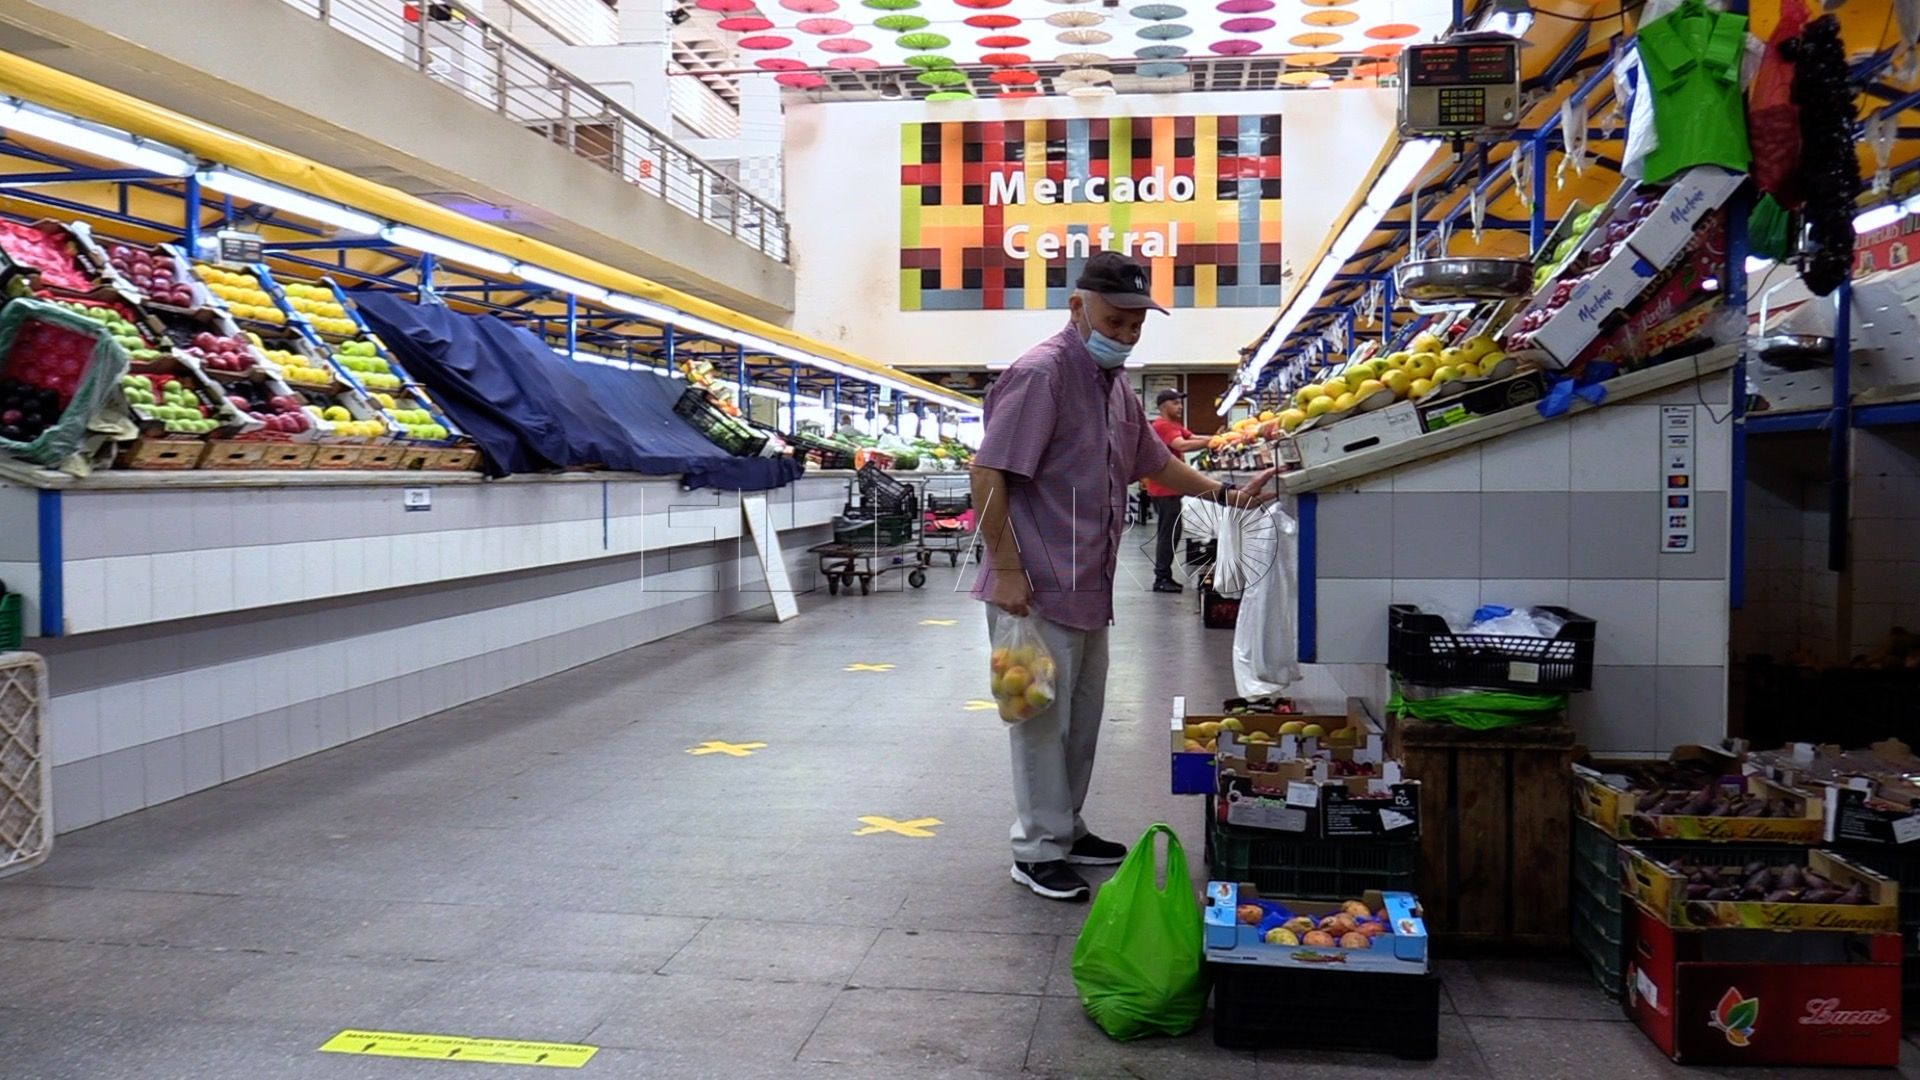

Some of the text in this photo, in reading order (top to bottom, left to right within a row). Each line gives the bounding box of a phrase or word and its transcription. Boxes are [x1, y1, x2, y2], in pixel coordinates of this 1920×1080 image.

[988, 166, 1194, 205] Mercado
[1003, 221, 1178, 259] Central
[1798, 997, 1892, 1025] Lucas
[345, 1033, 412, 1042] MANTENGA
